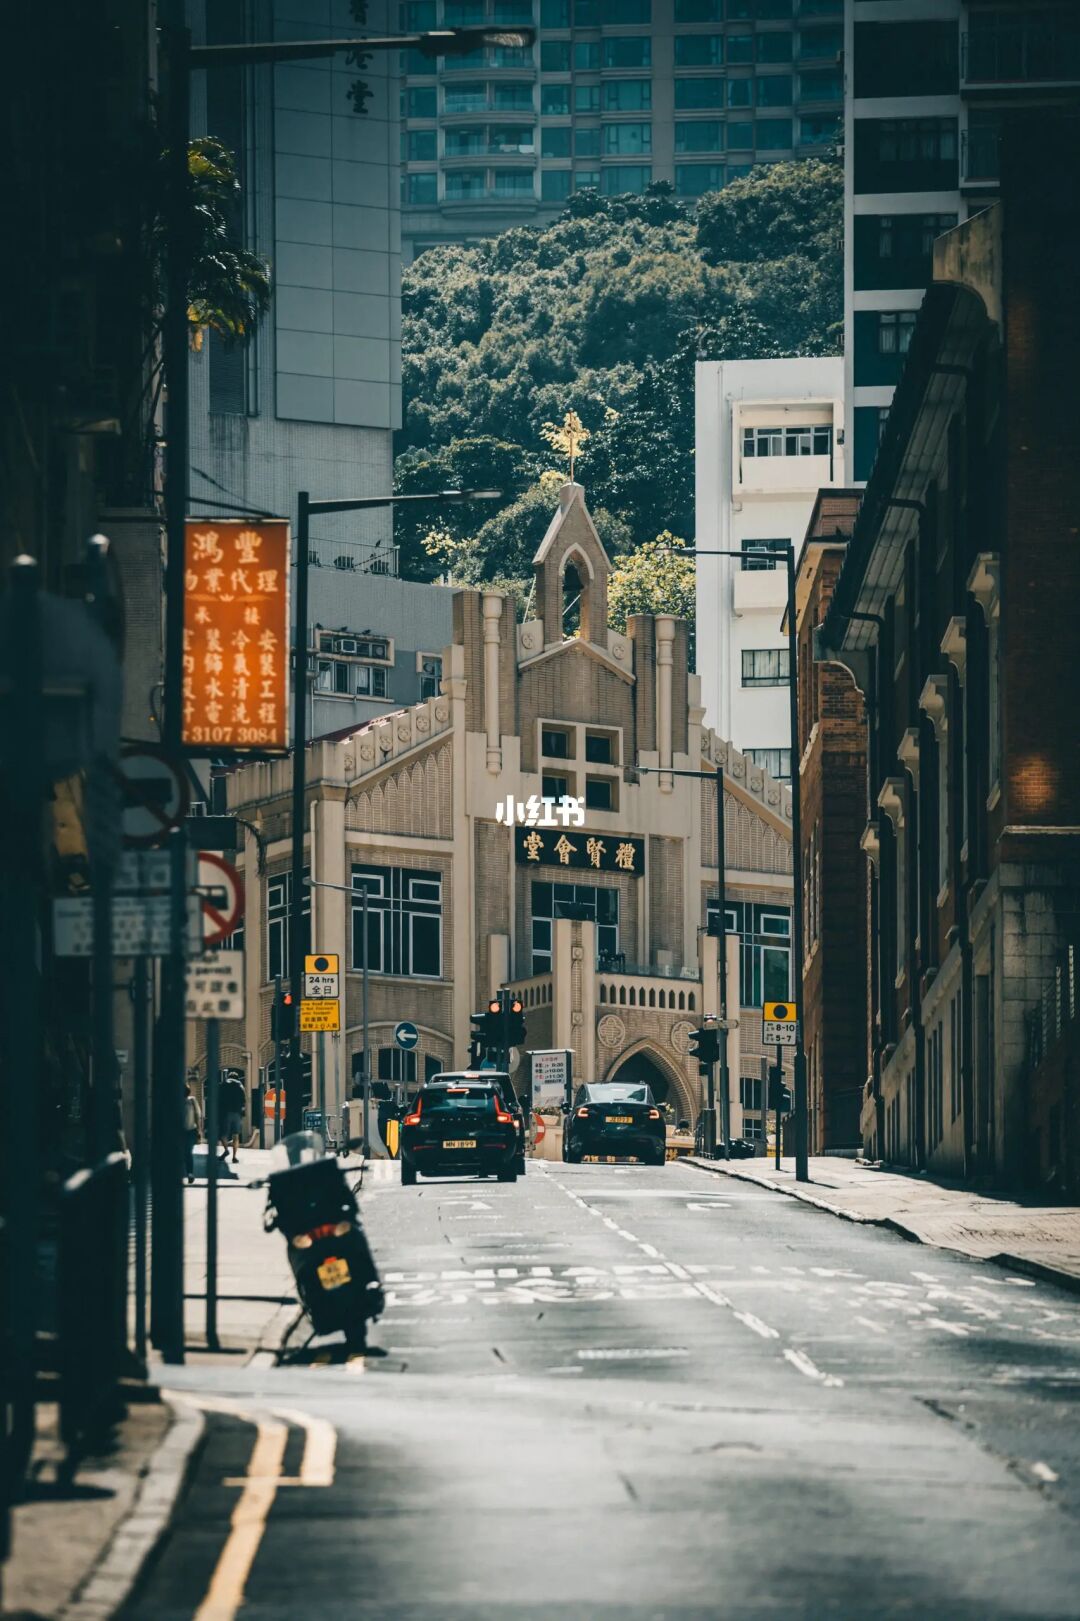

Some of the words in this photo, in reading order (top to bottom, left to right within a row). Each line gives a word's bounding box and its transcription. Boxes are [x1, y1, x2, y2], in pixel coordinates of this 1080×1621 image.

[192, 531, 263, 564] 鴻豐
[192, 727, 232, 743] 3107
[237, 727, 277, 743] 3084
[309, 976, 320, 984] 24
[322, 976, 335, 984] hrs
[312, 985, 332, 995] 全日
[776, 1024, 795, 1032] 8-10
